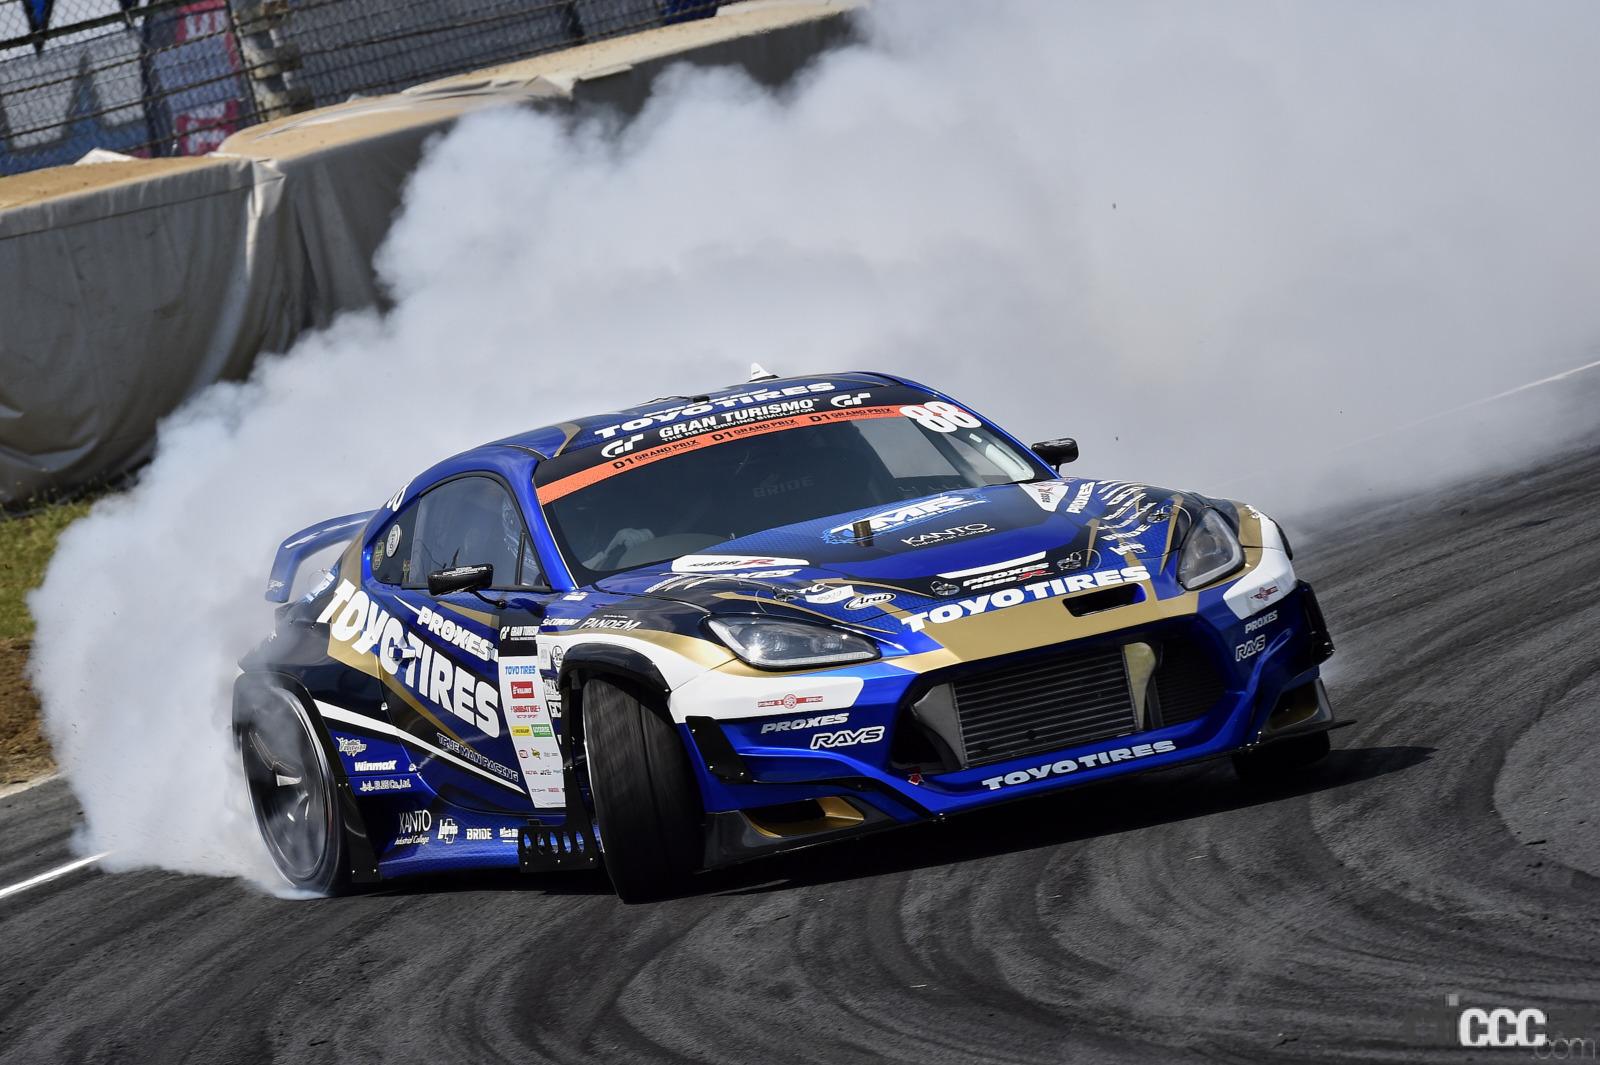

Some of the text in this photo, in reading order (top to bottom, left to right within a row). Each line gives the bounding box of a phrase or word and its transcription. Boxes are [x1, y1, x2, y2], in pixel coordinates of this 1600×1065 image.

[594, 403, 713, 439] TOYO
[715, 382, 836, 408] TIRES
[659, 416, 718, 439] GRAN
[721, 398, 813, 422] TURISMO
[684, 428, 713, 437] REAL
[713, 418, 755, 429] DRIVING
[757, 407, 815, 421] SIMULATOR
[809, 406, 896, 422] D1 GRAND PRIX
[899, 401, 982, 433] 88
[711, 418, 799, 441] D1 GRAND PRIX
[613, 439, 701, 469] D1 GRAND PRIX
[901, 523, 987, 545] KANTO
[912, 527, 995, 547] Industrial College
[963, 562, 1049, 587] PROXES
[900, 565, 1152, 633] TOYO TIRES
[416, 605, 494, 661] PROXES
[578, 617, 642, 631] PANDEM
[1245, 610, 1278, 634] PROXES
[1235, 634, 1266, 662] RAYS
[505, 665, 536, 675] TOYO TIRES
[406, 631, 500, 738] TIRES
[760, 712, 849, 734] PROXES
[810, 725, 885, 749] RAYS
[436, 732, 460, 754] TRUE
[481, 754, 519, 782] RACING
[982, 740, 1177, 790] TOYO TIRES
[399, 809, 432, 834] KANTO
[466, 828, 492, 840] BRIDE
